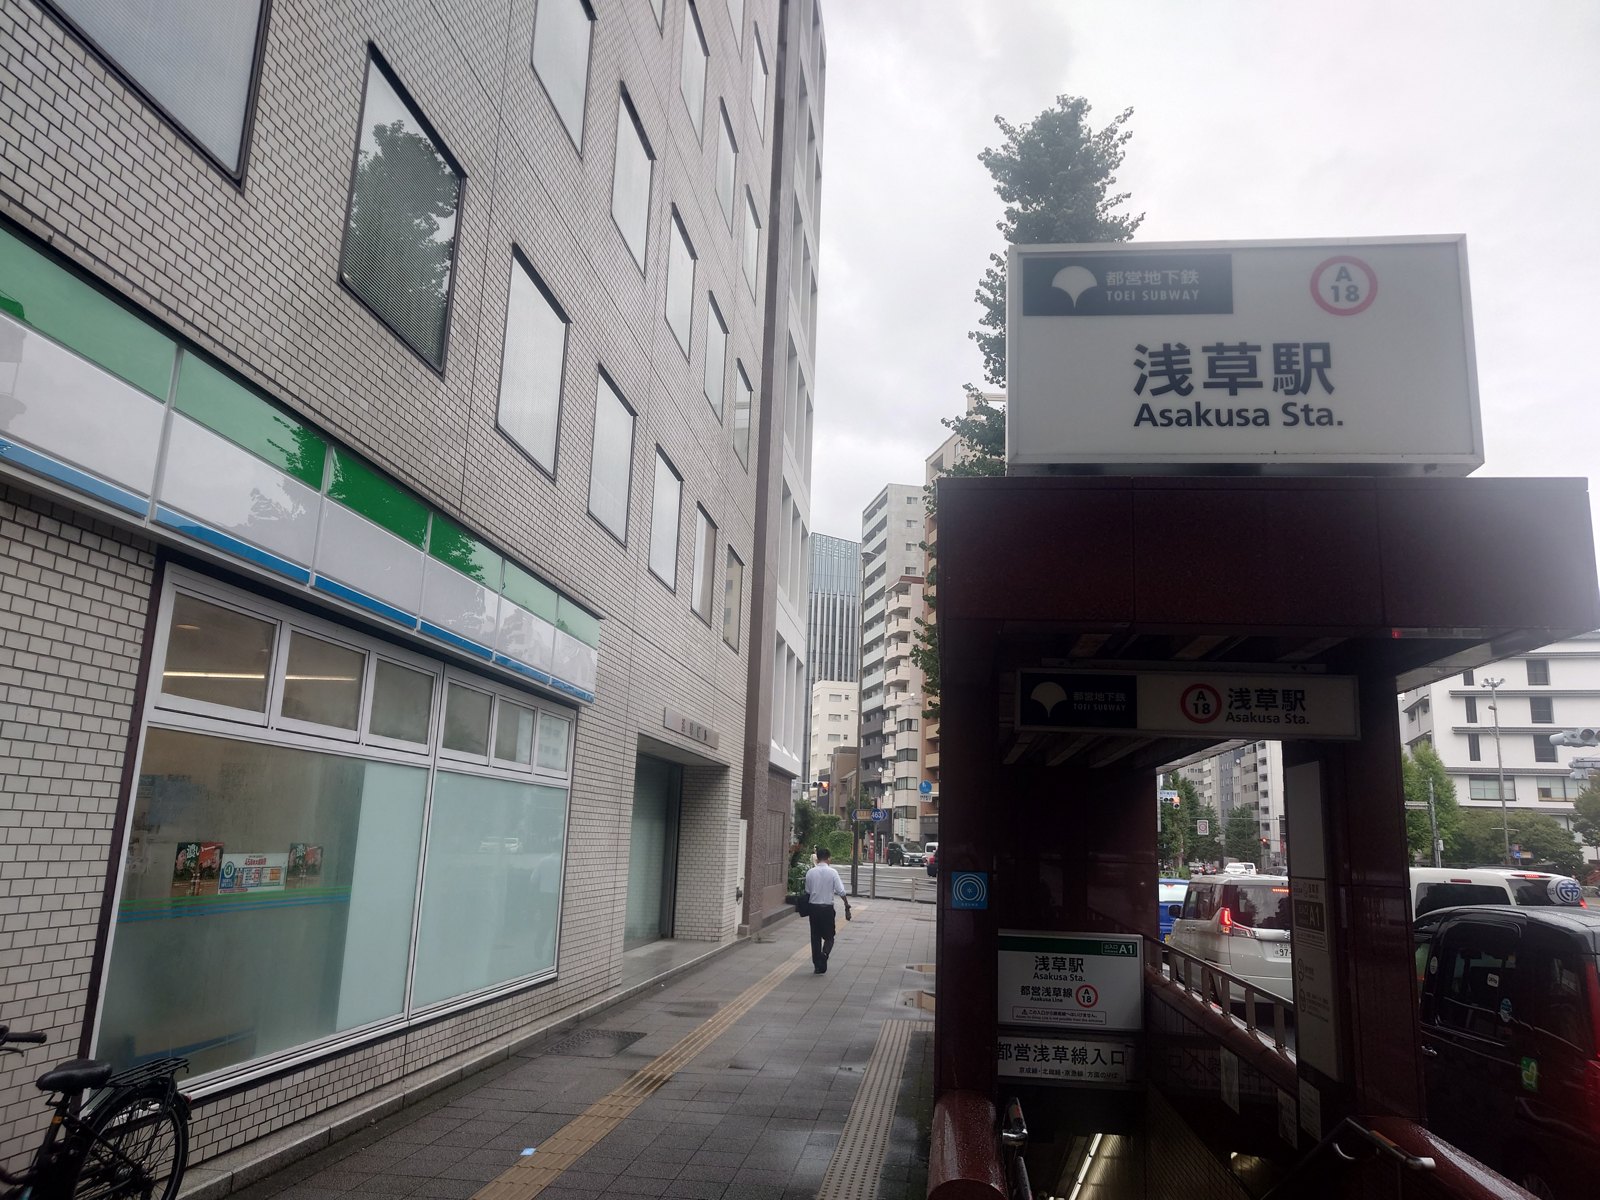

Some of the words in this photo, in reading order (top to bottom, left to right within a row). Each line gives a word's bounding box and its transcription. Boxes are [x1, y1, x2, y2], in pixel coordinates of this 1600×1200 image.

[1105, 269, 1201, 286] 都営地下鉄
[1335, 265, 1354, 283] A
[1105, 288, 1139, 302] TOEI
[1141, 287, 1201, 302] SUBWAY
[1330, 285, 1360, 303] 18
[1132, 341, 1335, 397] 浅草駅
[1132, 402, 1271, 428] Asakusa
[1281, 402, 1344, 427] Sta.
[1196, 690, 1207, 702] A
[1226, 688, 1306, 712] 浅草駅
[1192, 703, 1211, 715] 18
[1225, 711, 1281, 725] Asakusa
[1284, 712, 1310, 725] Sta.
[1118, 944, 1134, 955] A1
[1034, 955, 1085, 973] 浅草駅
[1033, 972, 1068, 982] Asakusa
[1069, 973, 1086, 982] Sta.
[1020, 985, 1073, 999] 都営浅草線
[1081, 995, 1092, 1003] 18
[997, 1041, 1125, 1066] 都営浅草線入口
